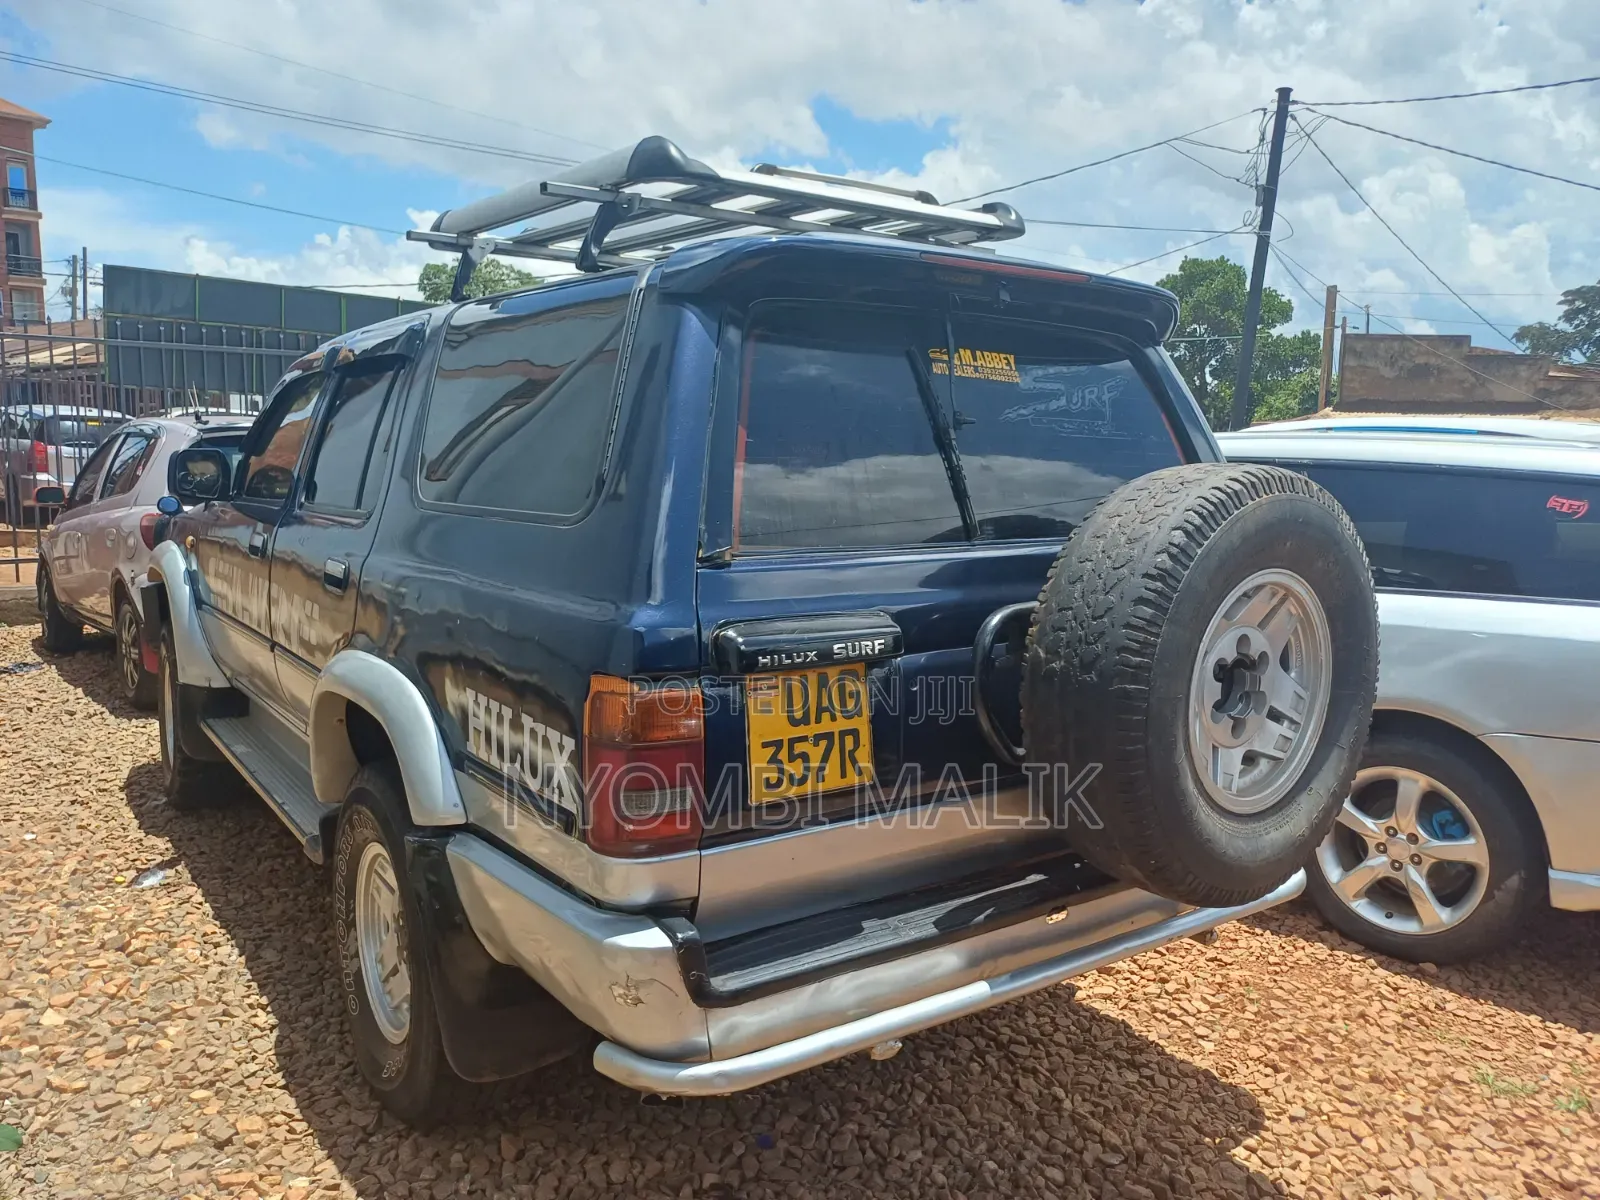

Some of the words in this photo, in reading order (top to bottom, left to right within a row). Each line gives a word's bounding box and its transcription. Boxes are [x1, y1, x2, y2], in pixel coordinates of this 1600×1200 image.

[932, 362, 949, 375] AUTO
[959, 348, 1016, 371] M.ABBEY
[758, 650, 818, 667] HILUX
[833, 639, 885, 659] SURF
[784, 669, 863, 728] UAG
[466, 687, 577, 814] HILUX
[761, 727, 864, 791] 357R
